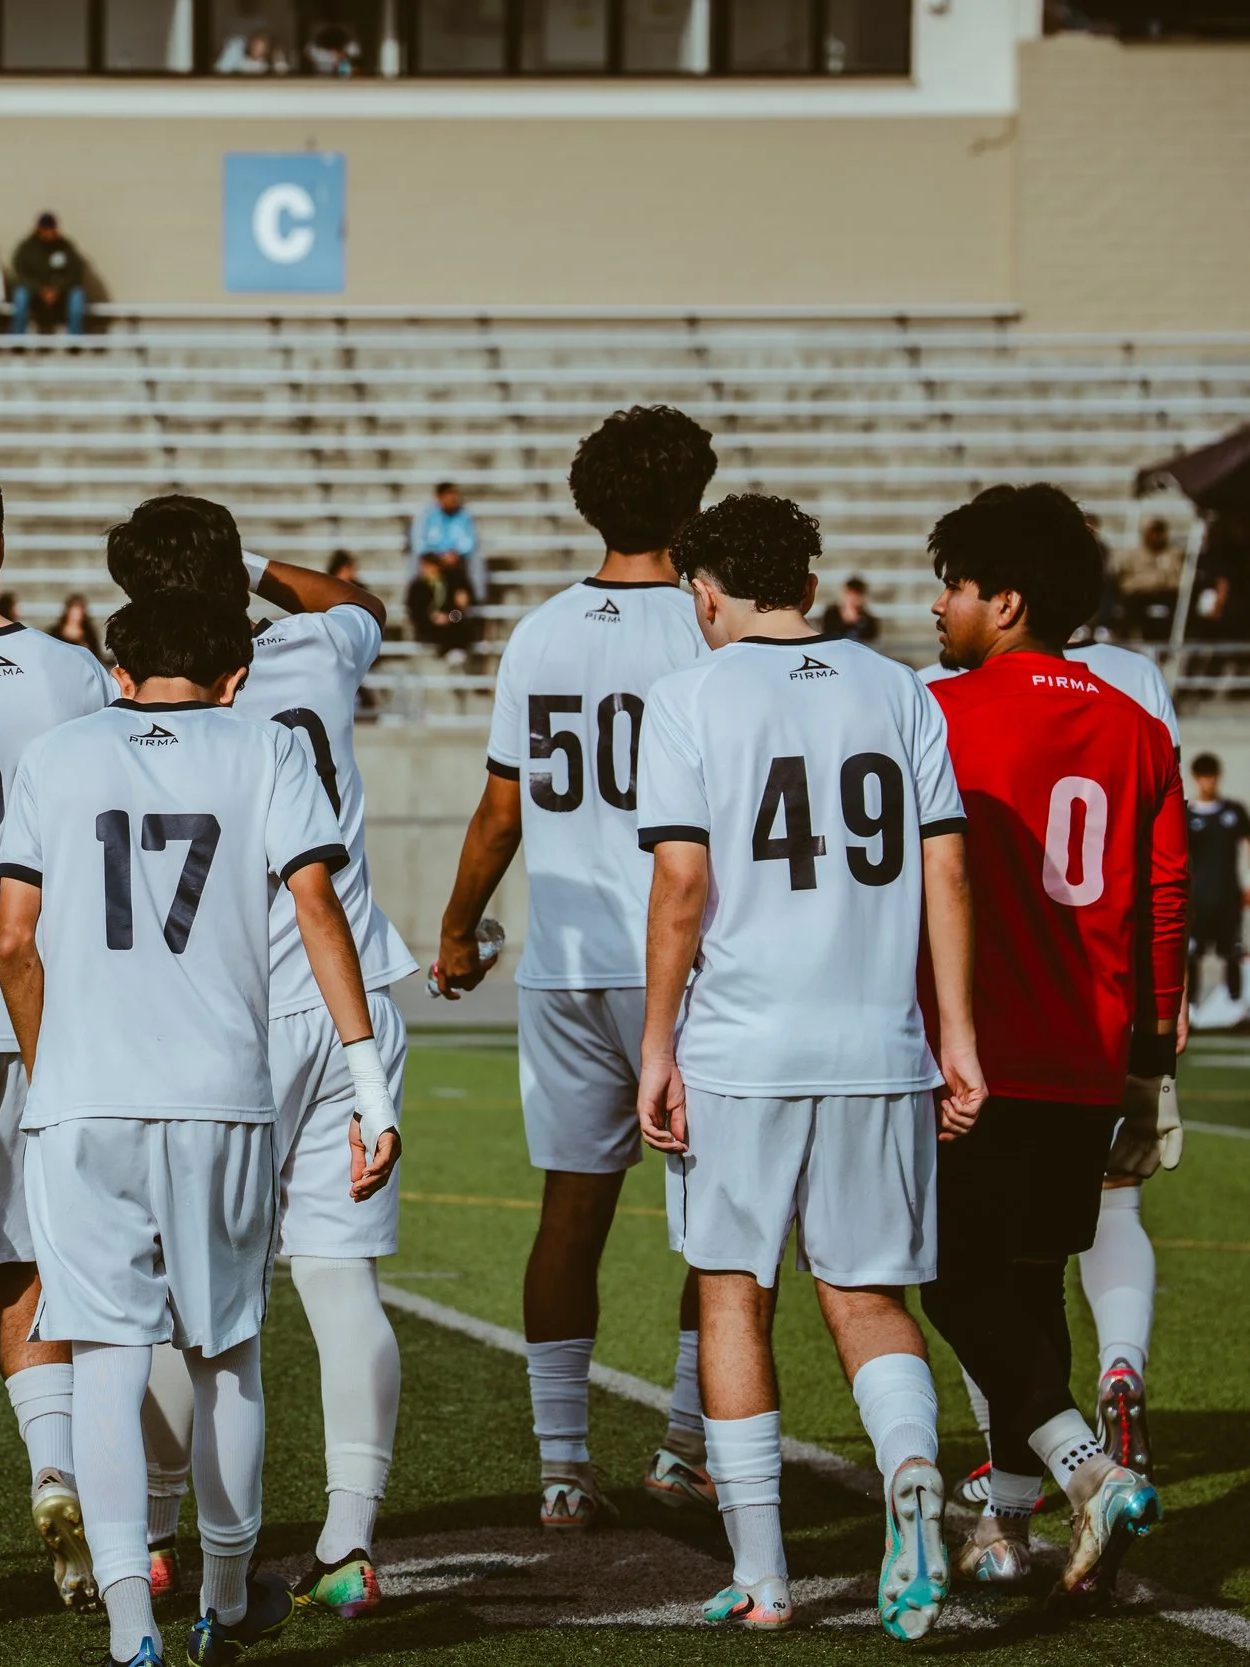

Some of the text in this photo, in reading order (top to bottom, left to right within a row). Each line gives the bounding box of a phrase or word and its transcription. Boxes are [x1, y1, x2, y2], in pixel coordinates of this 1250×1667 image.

[252, 182, 316, 263] C
[584, 611, 621, 623] PIRM
[789, 669, 839, 680] PIRMA
[1032, 675, 1099, 694] PIRMA
[129, 735, 179, 747] PIRMA
[528, 692, 645, 813] 50
[752, 752, 904, 891] 49
[1042, 775, 1108, 906] 0
[95, 809, 222, 955] 17
